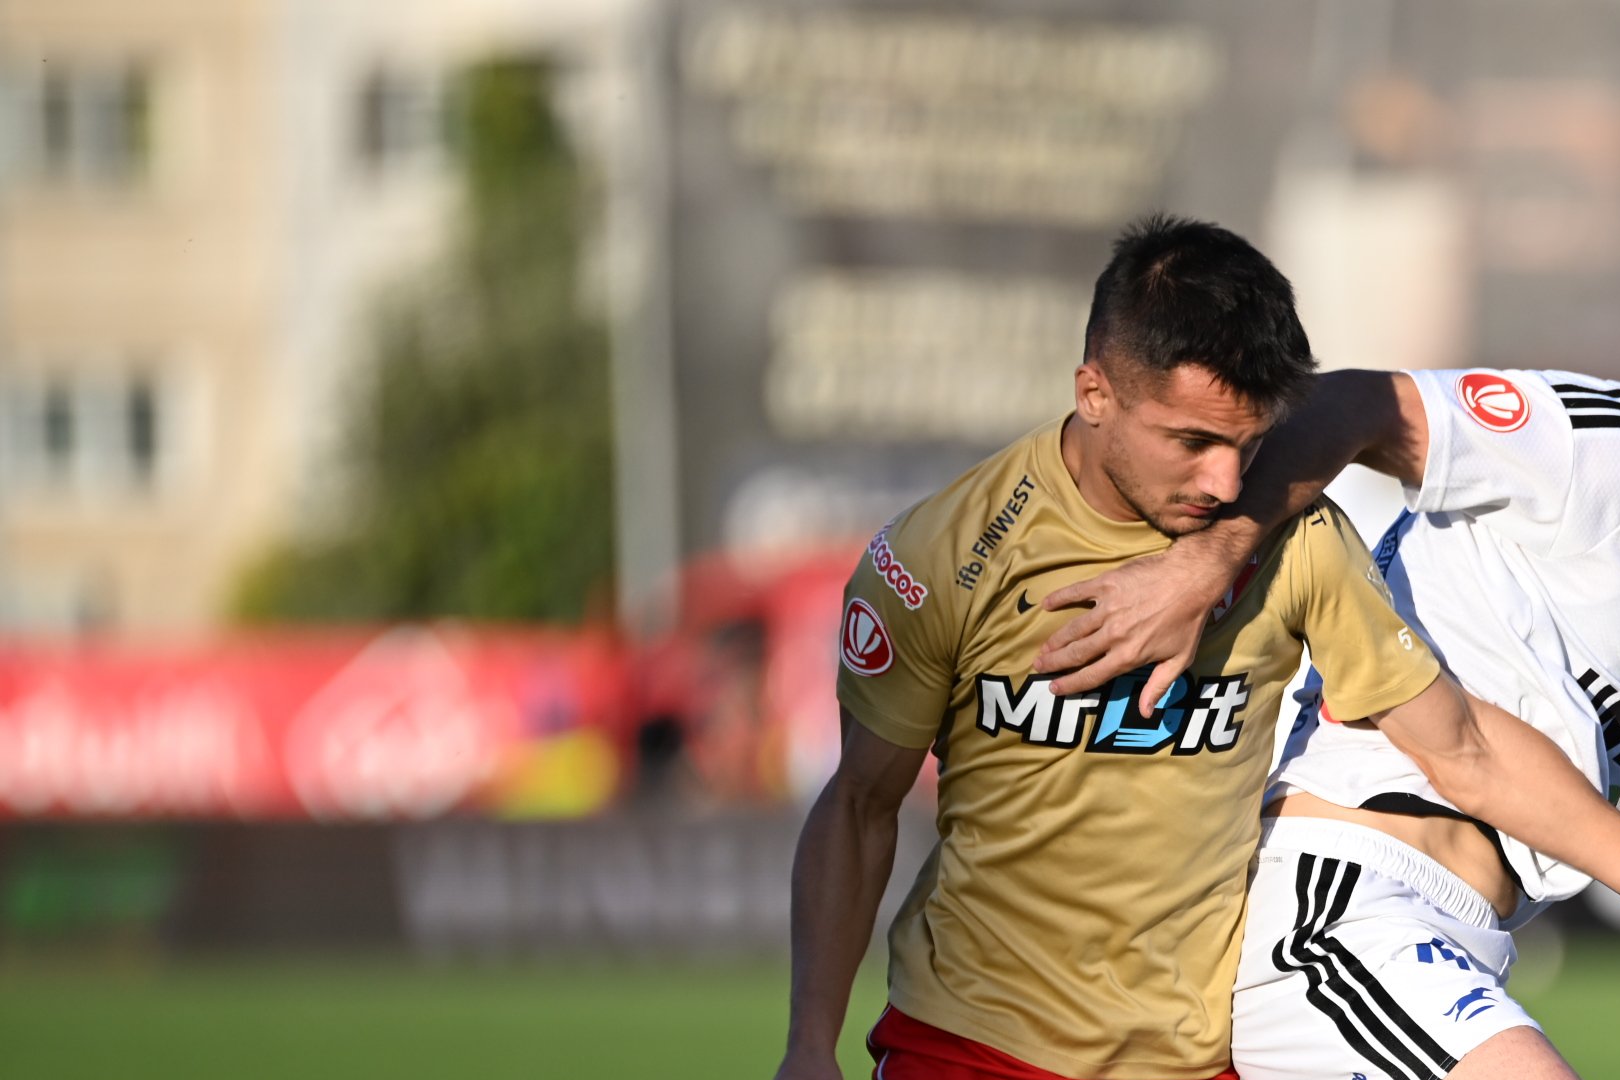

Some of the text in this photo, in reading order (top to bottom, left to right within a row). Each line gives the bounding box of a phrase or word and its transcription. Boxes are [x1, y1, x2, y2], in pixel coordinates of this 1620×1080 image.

[956, 475, 1036, 591] ifb FINWEST
[979, 668, 1250, 754] MrBit
